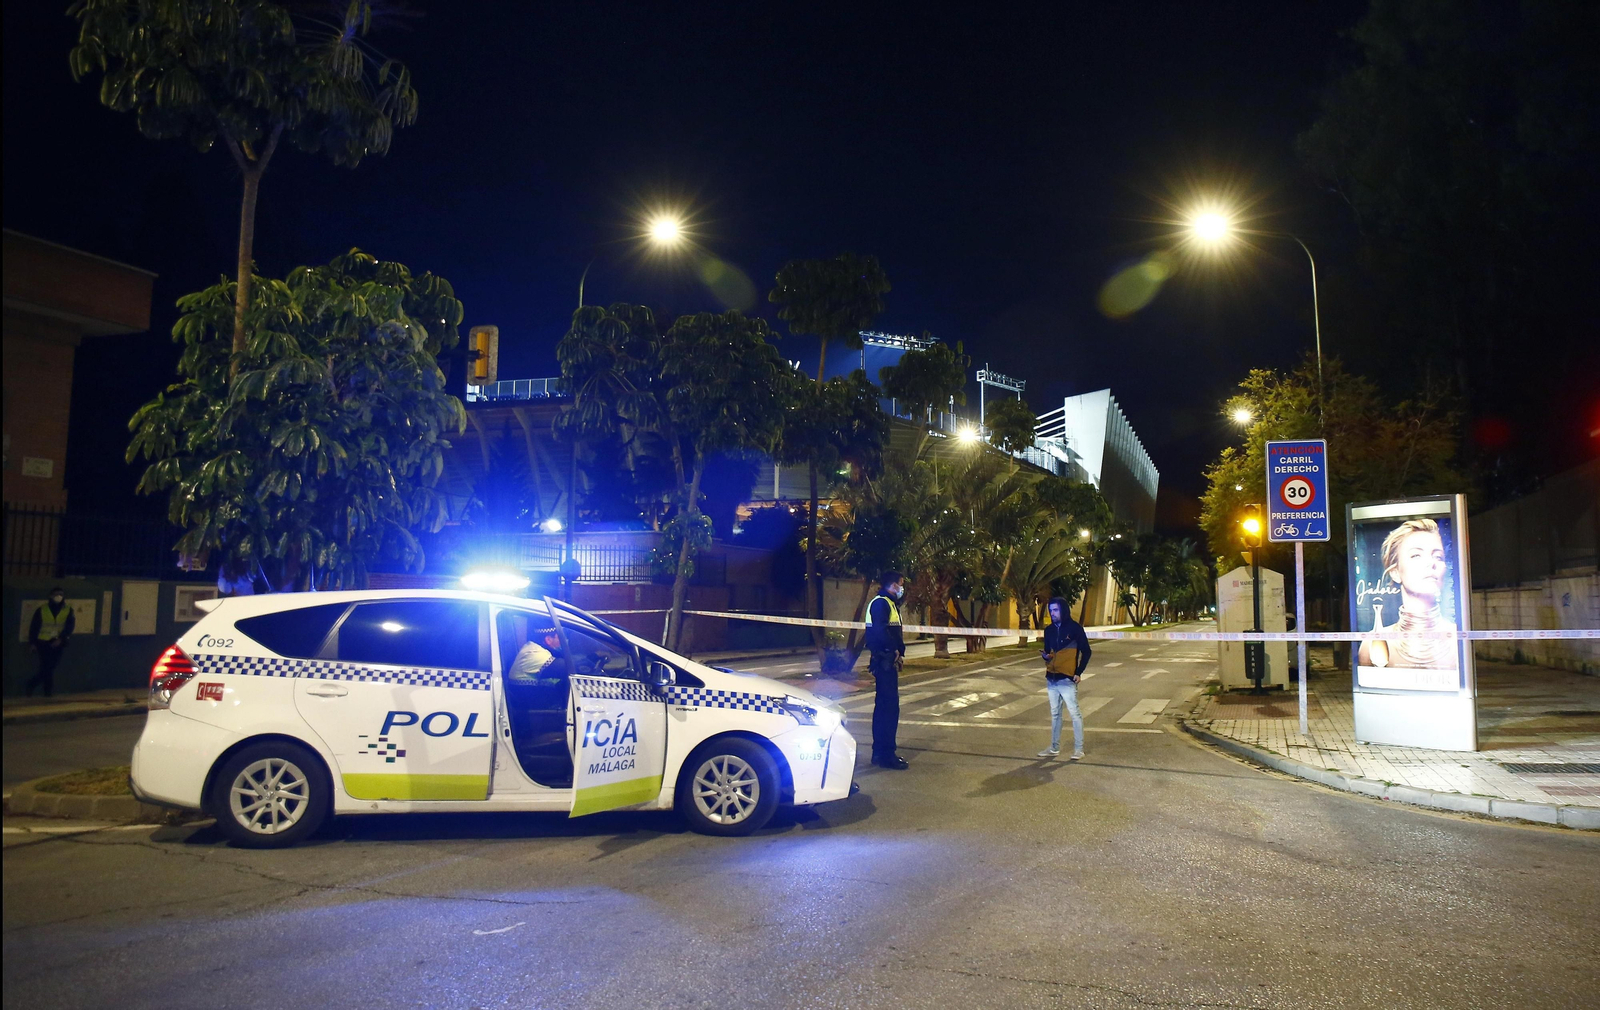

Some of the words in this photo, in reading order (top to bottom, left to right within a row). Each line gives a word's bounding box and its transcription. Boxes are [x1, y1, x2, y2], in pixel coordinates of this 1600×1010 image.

[1271, 445, 1323, 455] ATENCIÓN
[1279, 456, 1313, 464] CARRIL
[1274, 465, 1319, 474] DERECHO
[1287, 486, 1308, 498] 30
[1271, 511, 1326, 520] PREFERENCIA
[207, 638, 234, 648] 092
[206, 685, 223, 694] 112
[379, 710, 489, 738] POL
[582, 712, 638, 748] ICÍA
[602, 745, 637, 759] LOCAL
[588, 758, 636, 775] MÁLAGA
